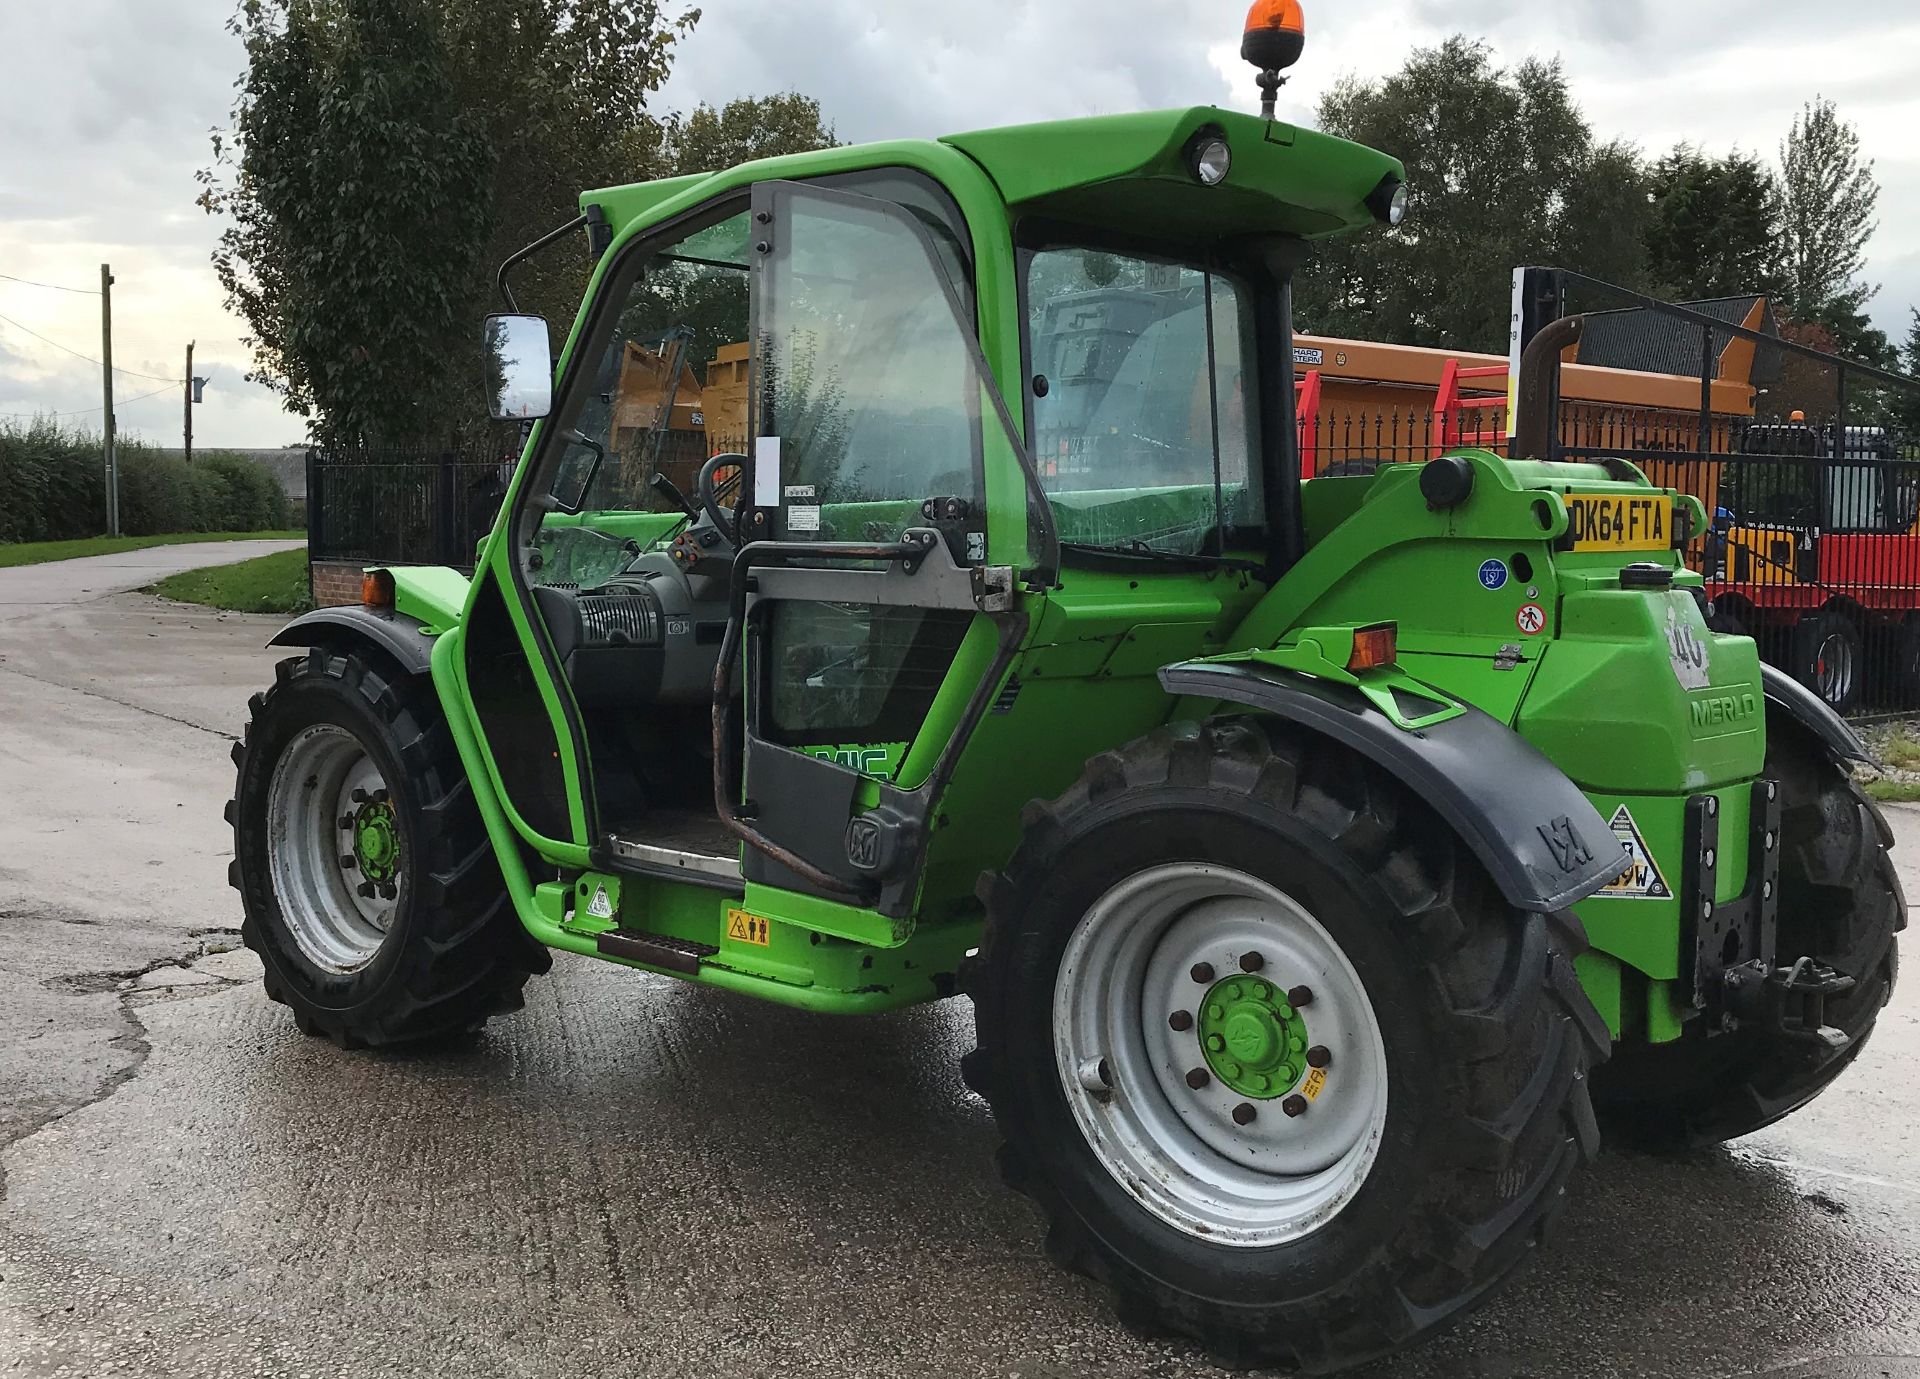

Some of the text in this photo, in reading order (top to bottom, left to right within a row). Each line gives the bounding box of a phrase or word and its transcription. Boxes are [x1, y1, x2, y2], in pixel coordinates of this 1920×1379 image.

[1572, 499, 1663, 541] DK64 FTA
[1690, 692, 1755, 728] MERLO
